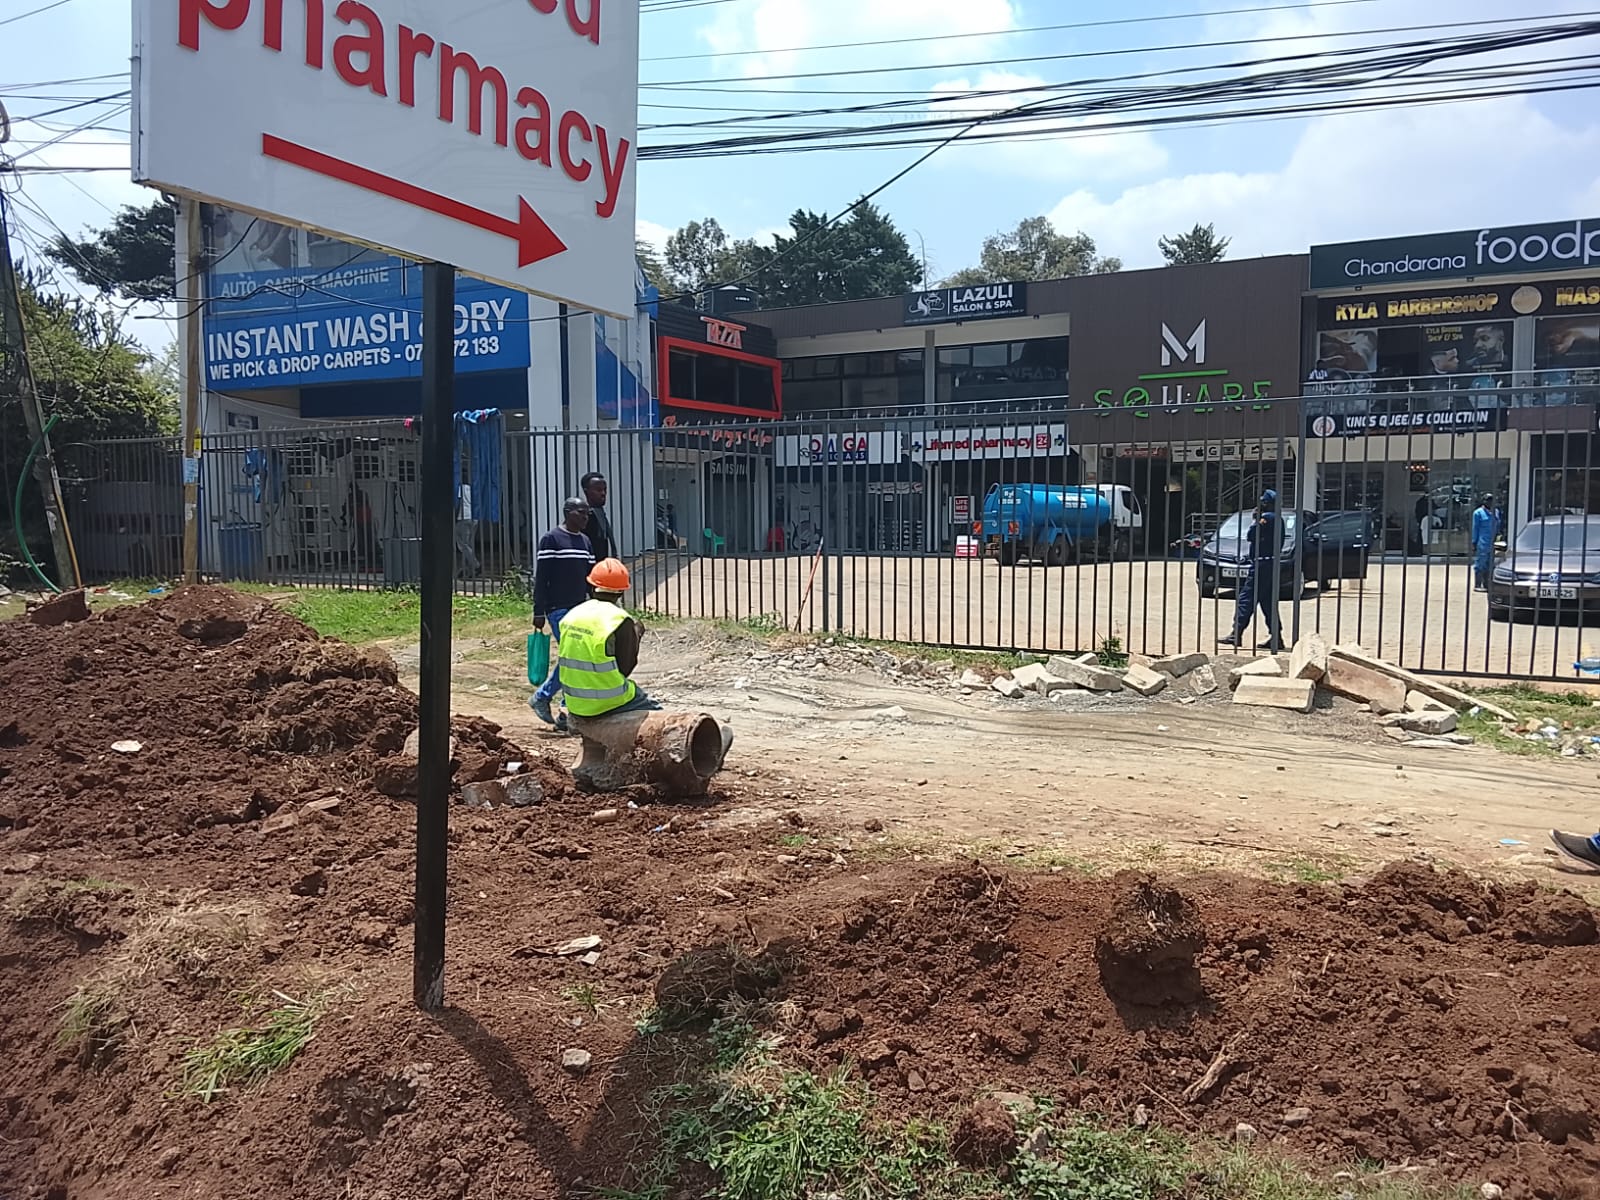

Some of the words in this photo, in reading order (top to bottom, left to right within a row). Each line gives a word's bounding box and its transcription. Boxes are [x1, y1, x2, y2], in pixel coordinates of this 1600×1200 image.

[1344, 255, 1466, 277] Chandarana
[1475, 220, 1600, 265] foodp
[221, 280, 257, 297] AUTO
[322, 267, 389, 288] MACHINE
[952, 284, 1013, 303] LAZULI
[1556, 286, 1600, 306] MAS
[953, 302, 983, 313] SALON
[985, 301, 992, 310] &
[994, 300, 1013, 309] SPA
[1335, 302, 1378, 321] KYLA
[1387, 293, 1498, 318] BARBERSHOP
[209, 321, 319, 362] INSTANT
[326, 311, 410, 349] WASH
[1161, 318, 1206, 367] M
[210, 364, 230, 381] WE
[233, 359, 265, 378] PICK
[267, 359, 279, 375] &
[281, 354, 320, 374] DROP
[323, 346, 391, 372] CARPETS
[473, 335, 500, 356] 133
[1094, 381, 1271, 418] SQUARE
[811, 452, 865, 461] OPICANS
[973, 436, 1031, 451] pharmacy
[711, 462, 748, 475] SAMSUN
